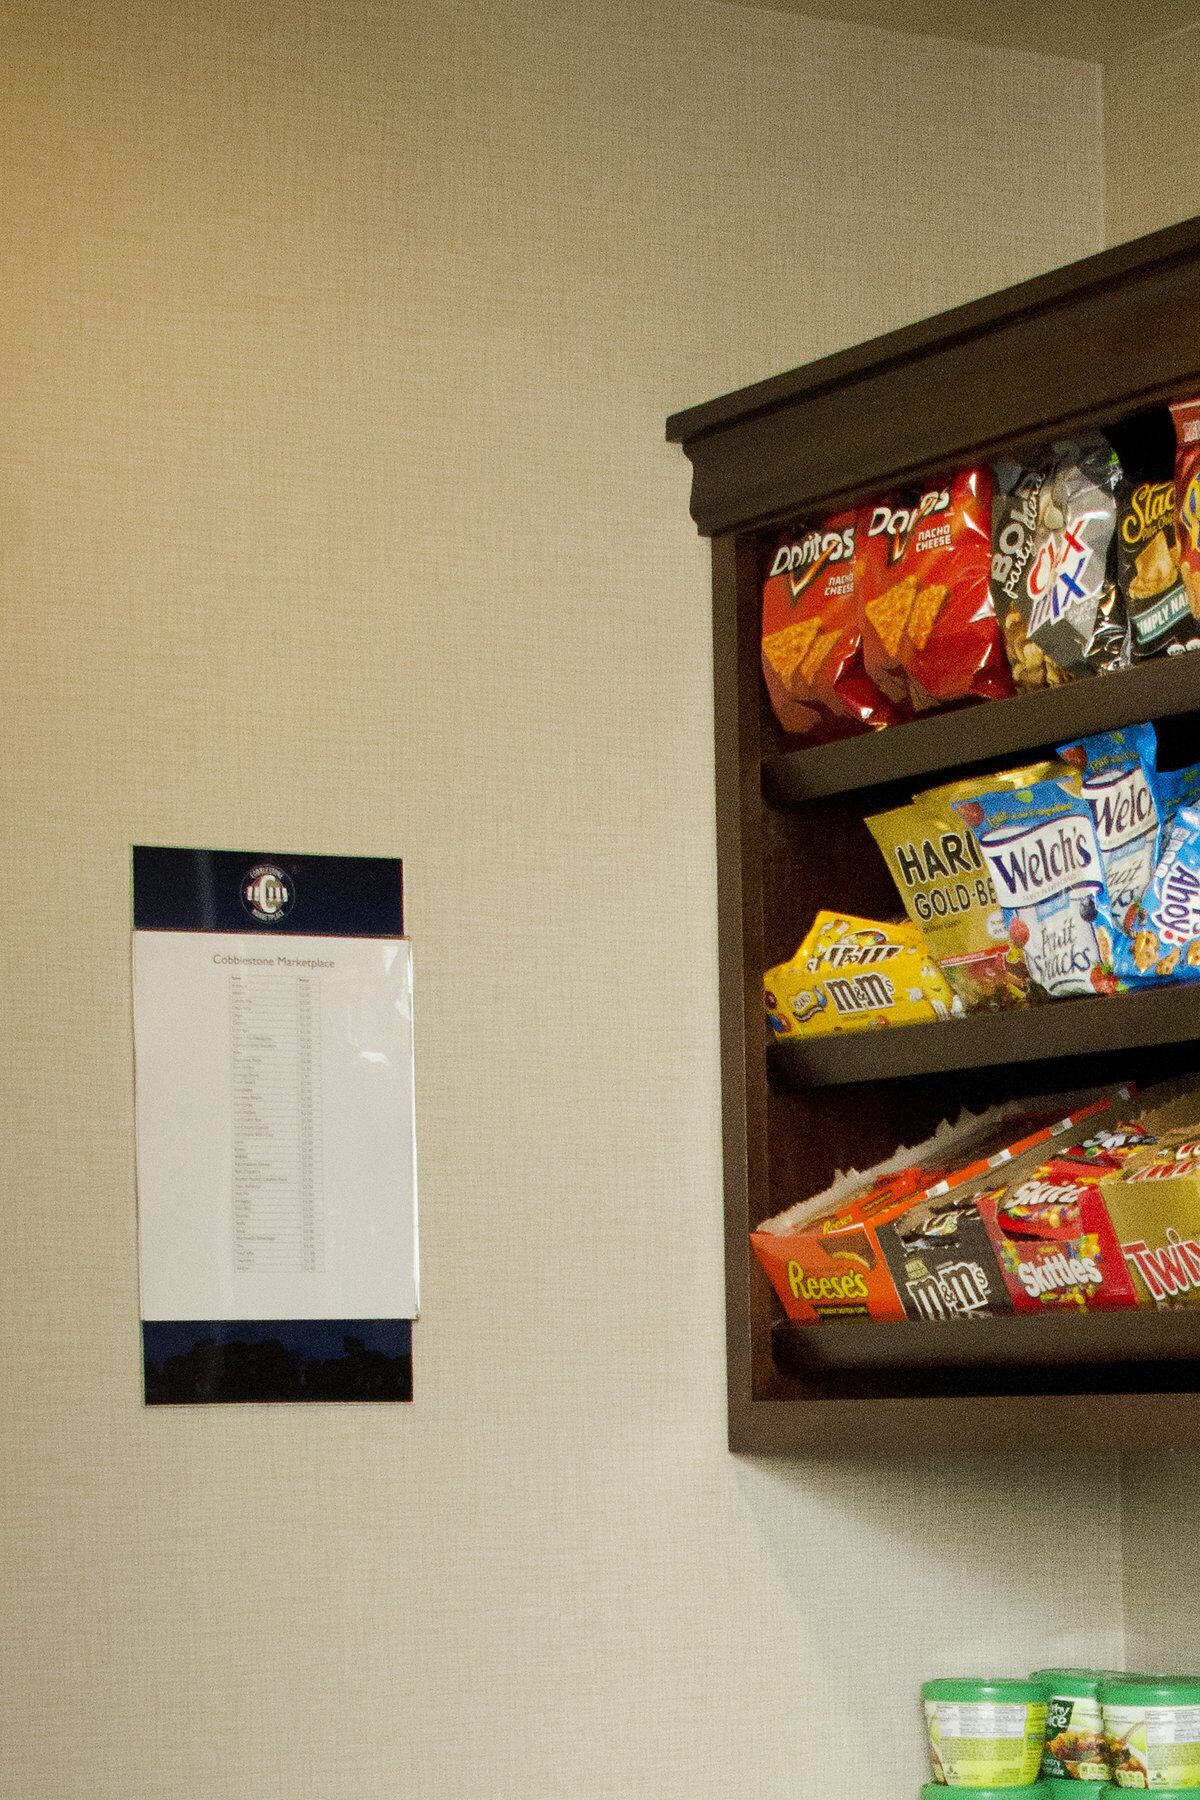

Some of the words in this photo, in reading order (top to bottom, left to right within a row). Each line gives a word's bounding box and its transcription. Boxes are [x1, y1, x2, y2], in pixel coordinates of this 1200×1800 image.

[915, 534, 952, 554] CHEESE
[918, 523, 952, 540] NACHO
[770, 527, 856, 578] Doritos
[824, 582, 855, 597] CHEESE
[1137, 602, 1168, 637] IMPLY
[989, 826, 1093, 895] Welch's
[212, 953, 275, 967] Cobblestone
[276, 956, 336, 971] Marketplace
[787, 1259, 869, 1300] Reese's
[1018, 1253, 1103, 1298] Skittles
